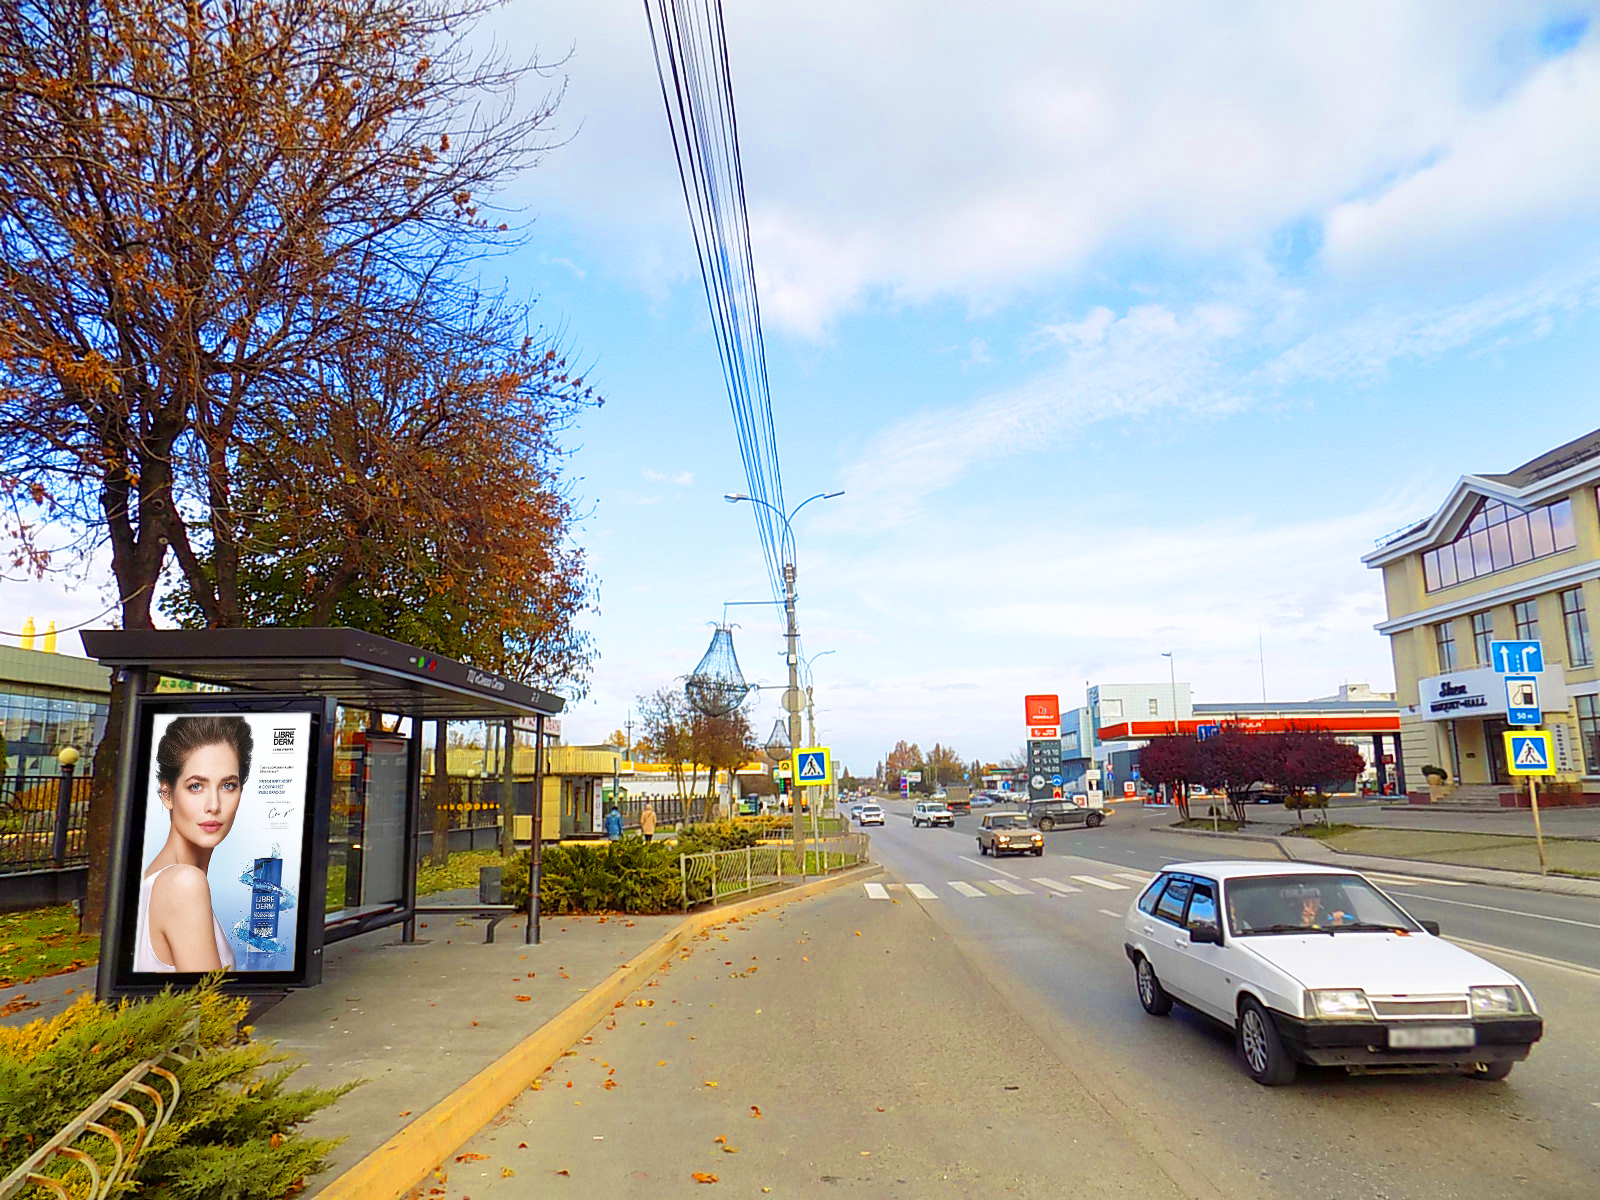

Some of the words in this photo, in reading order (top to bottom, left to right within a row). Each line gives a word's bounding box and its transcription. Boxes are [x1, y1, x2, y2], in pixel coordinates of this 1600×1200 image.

[1516, 712, 1527, 720] 50
[273, 731, 295, 739] LIBRE
[273, 738, 295, 746] DERM
[255, 895, 275, 903] LIBRE
